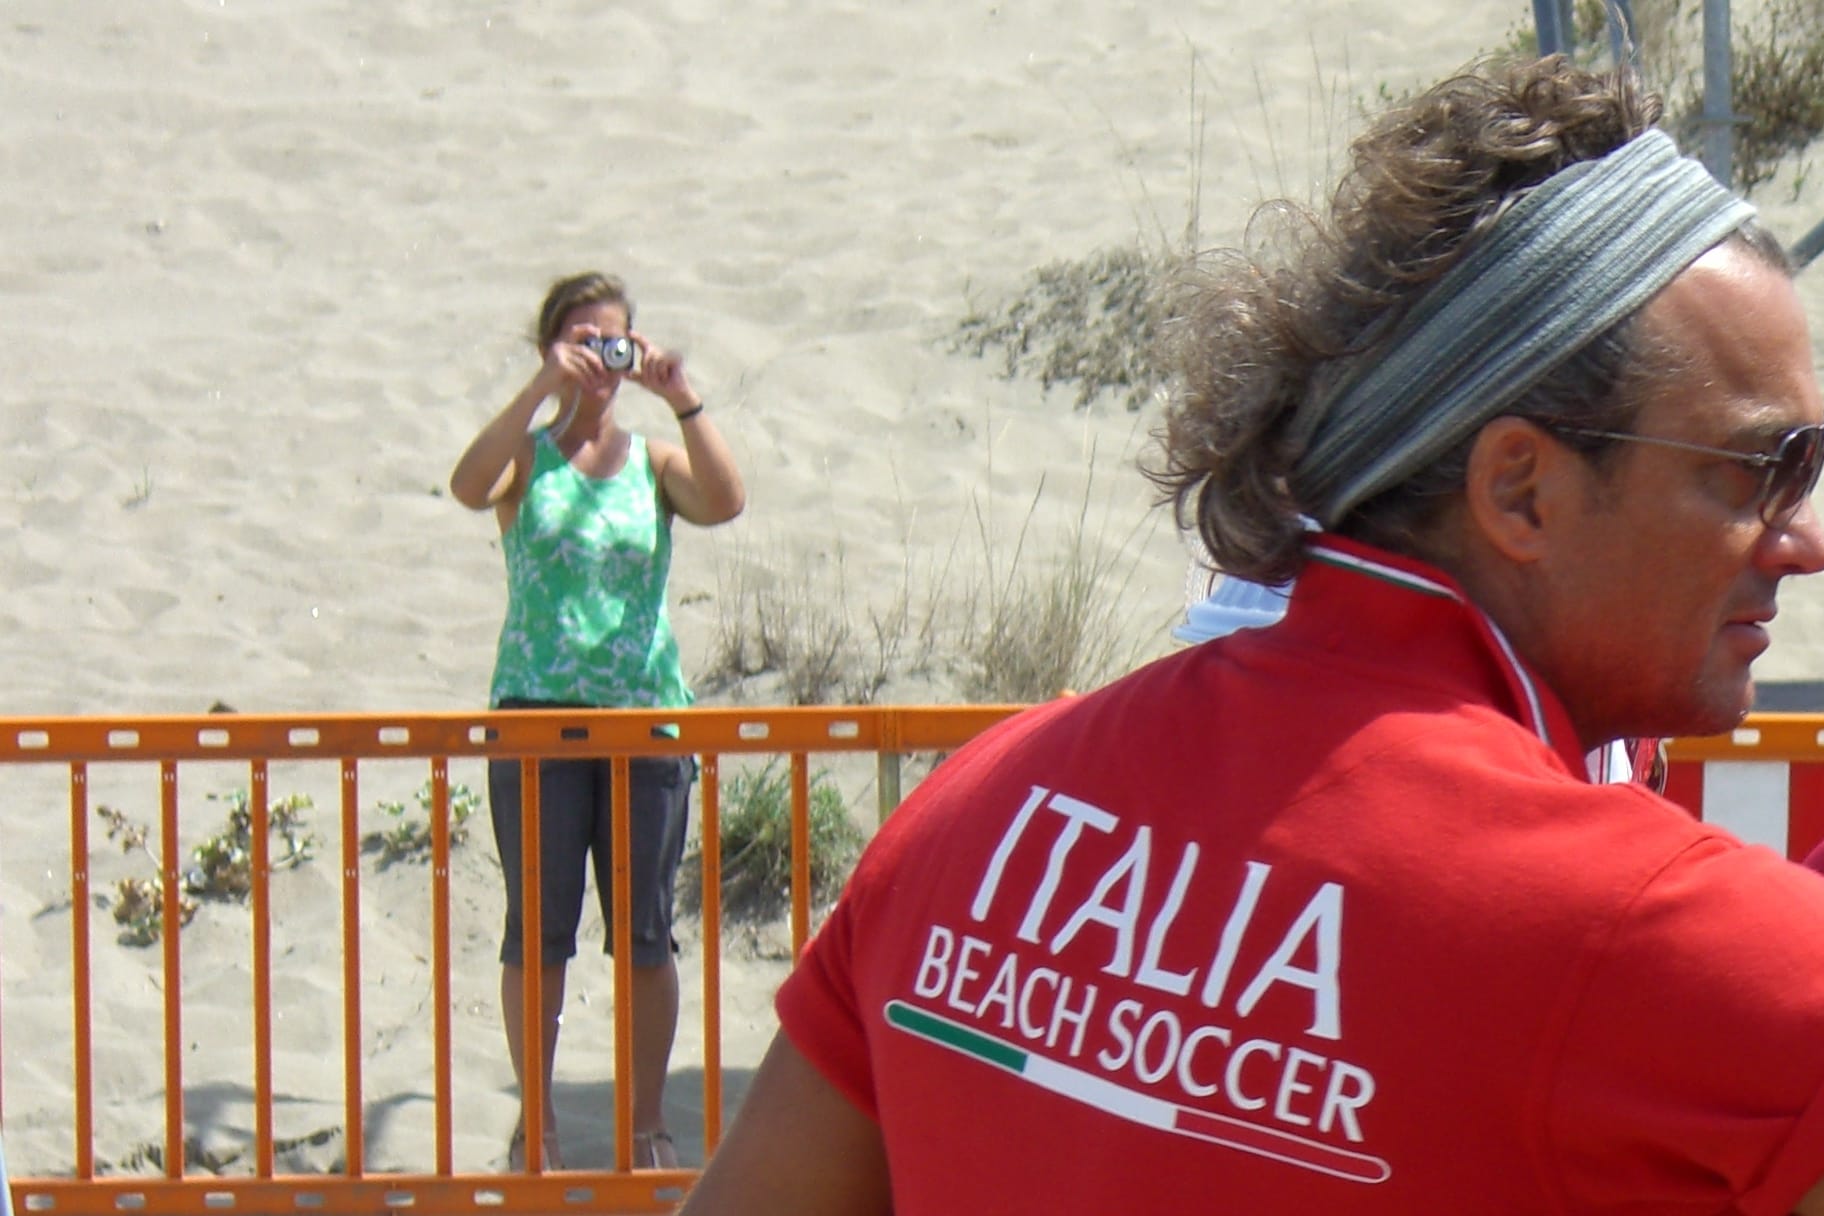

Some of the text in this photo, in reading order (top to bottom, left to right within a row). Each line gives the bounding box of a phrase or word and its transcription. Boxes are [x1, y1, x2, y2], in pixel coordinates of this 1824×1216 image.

[970, 785, 1344, 1040] ITALIA
[914, 925, 1376, 1142] BEACH SOCCER
